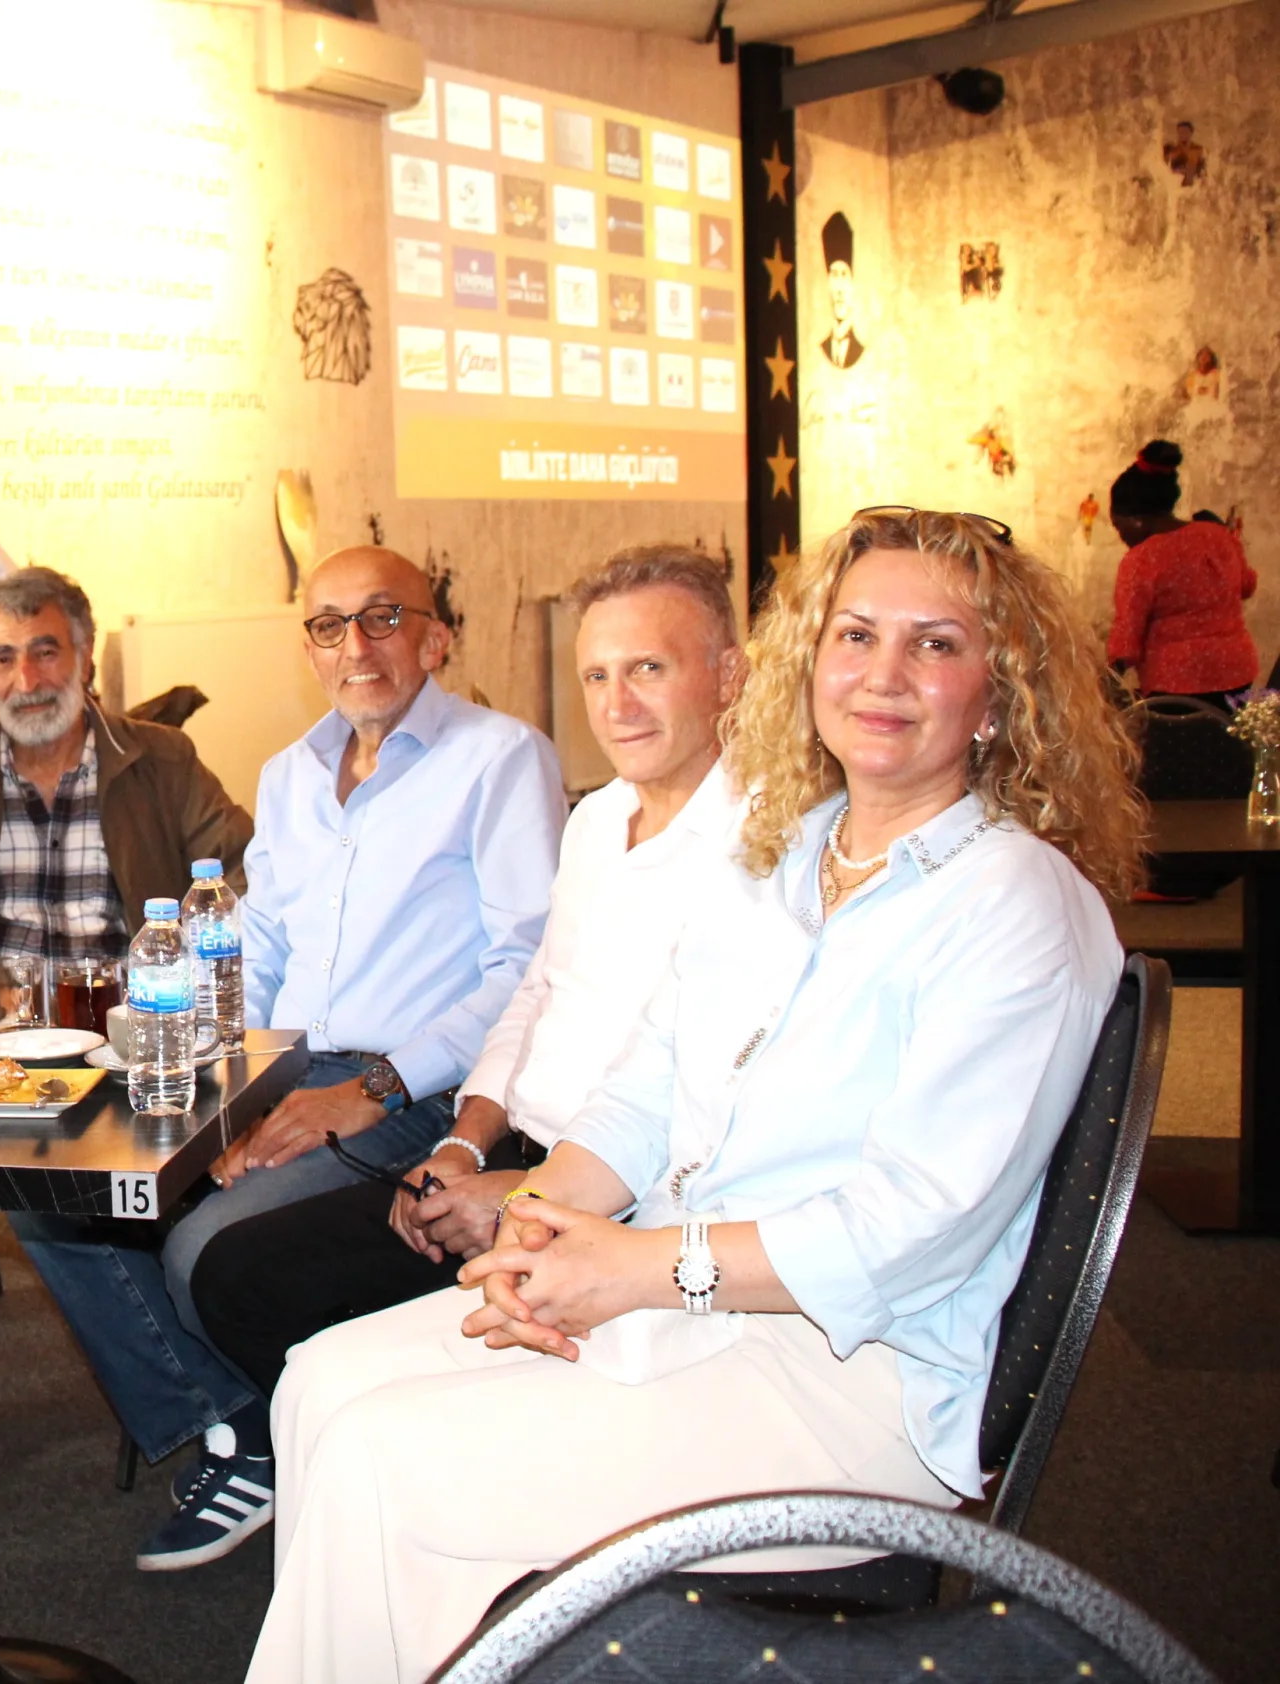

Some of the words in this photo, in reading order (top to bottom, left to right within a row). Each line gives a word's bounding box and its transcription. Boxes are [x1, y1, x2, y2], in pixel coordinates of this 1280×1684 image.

[23, 426, 105, 463] kültürün
[569, 452, 607, 481] DAHA
[59, 470, 96, 501] anlı
[101, 470, 143, 506] şanlı
[117, 1179, 151, 1213] 15
